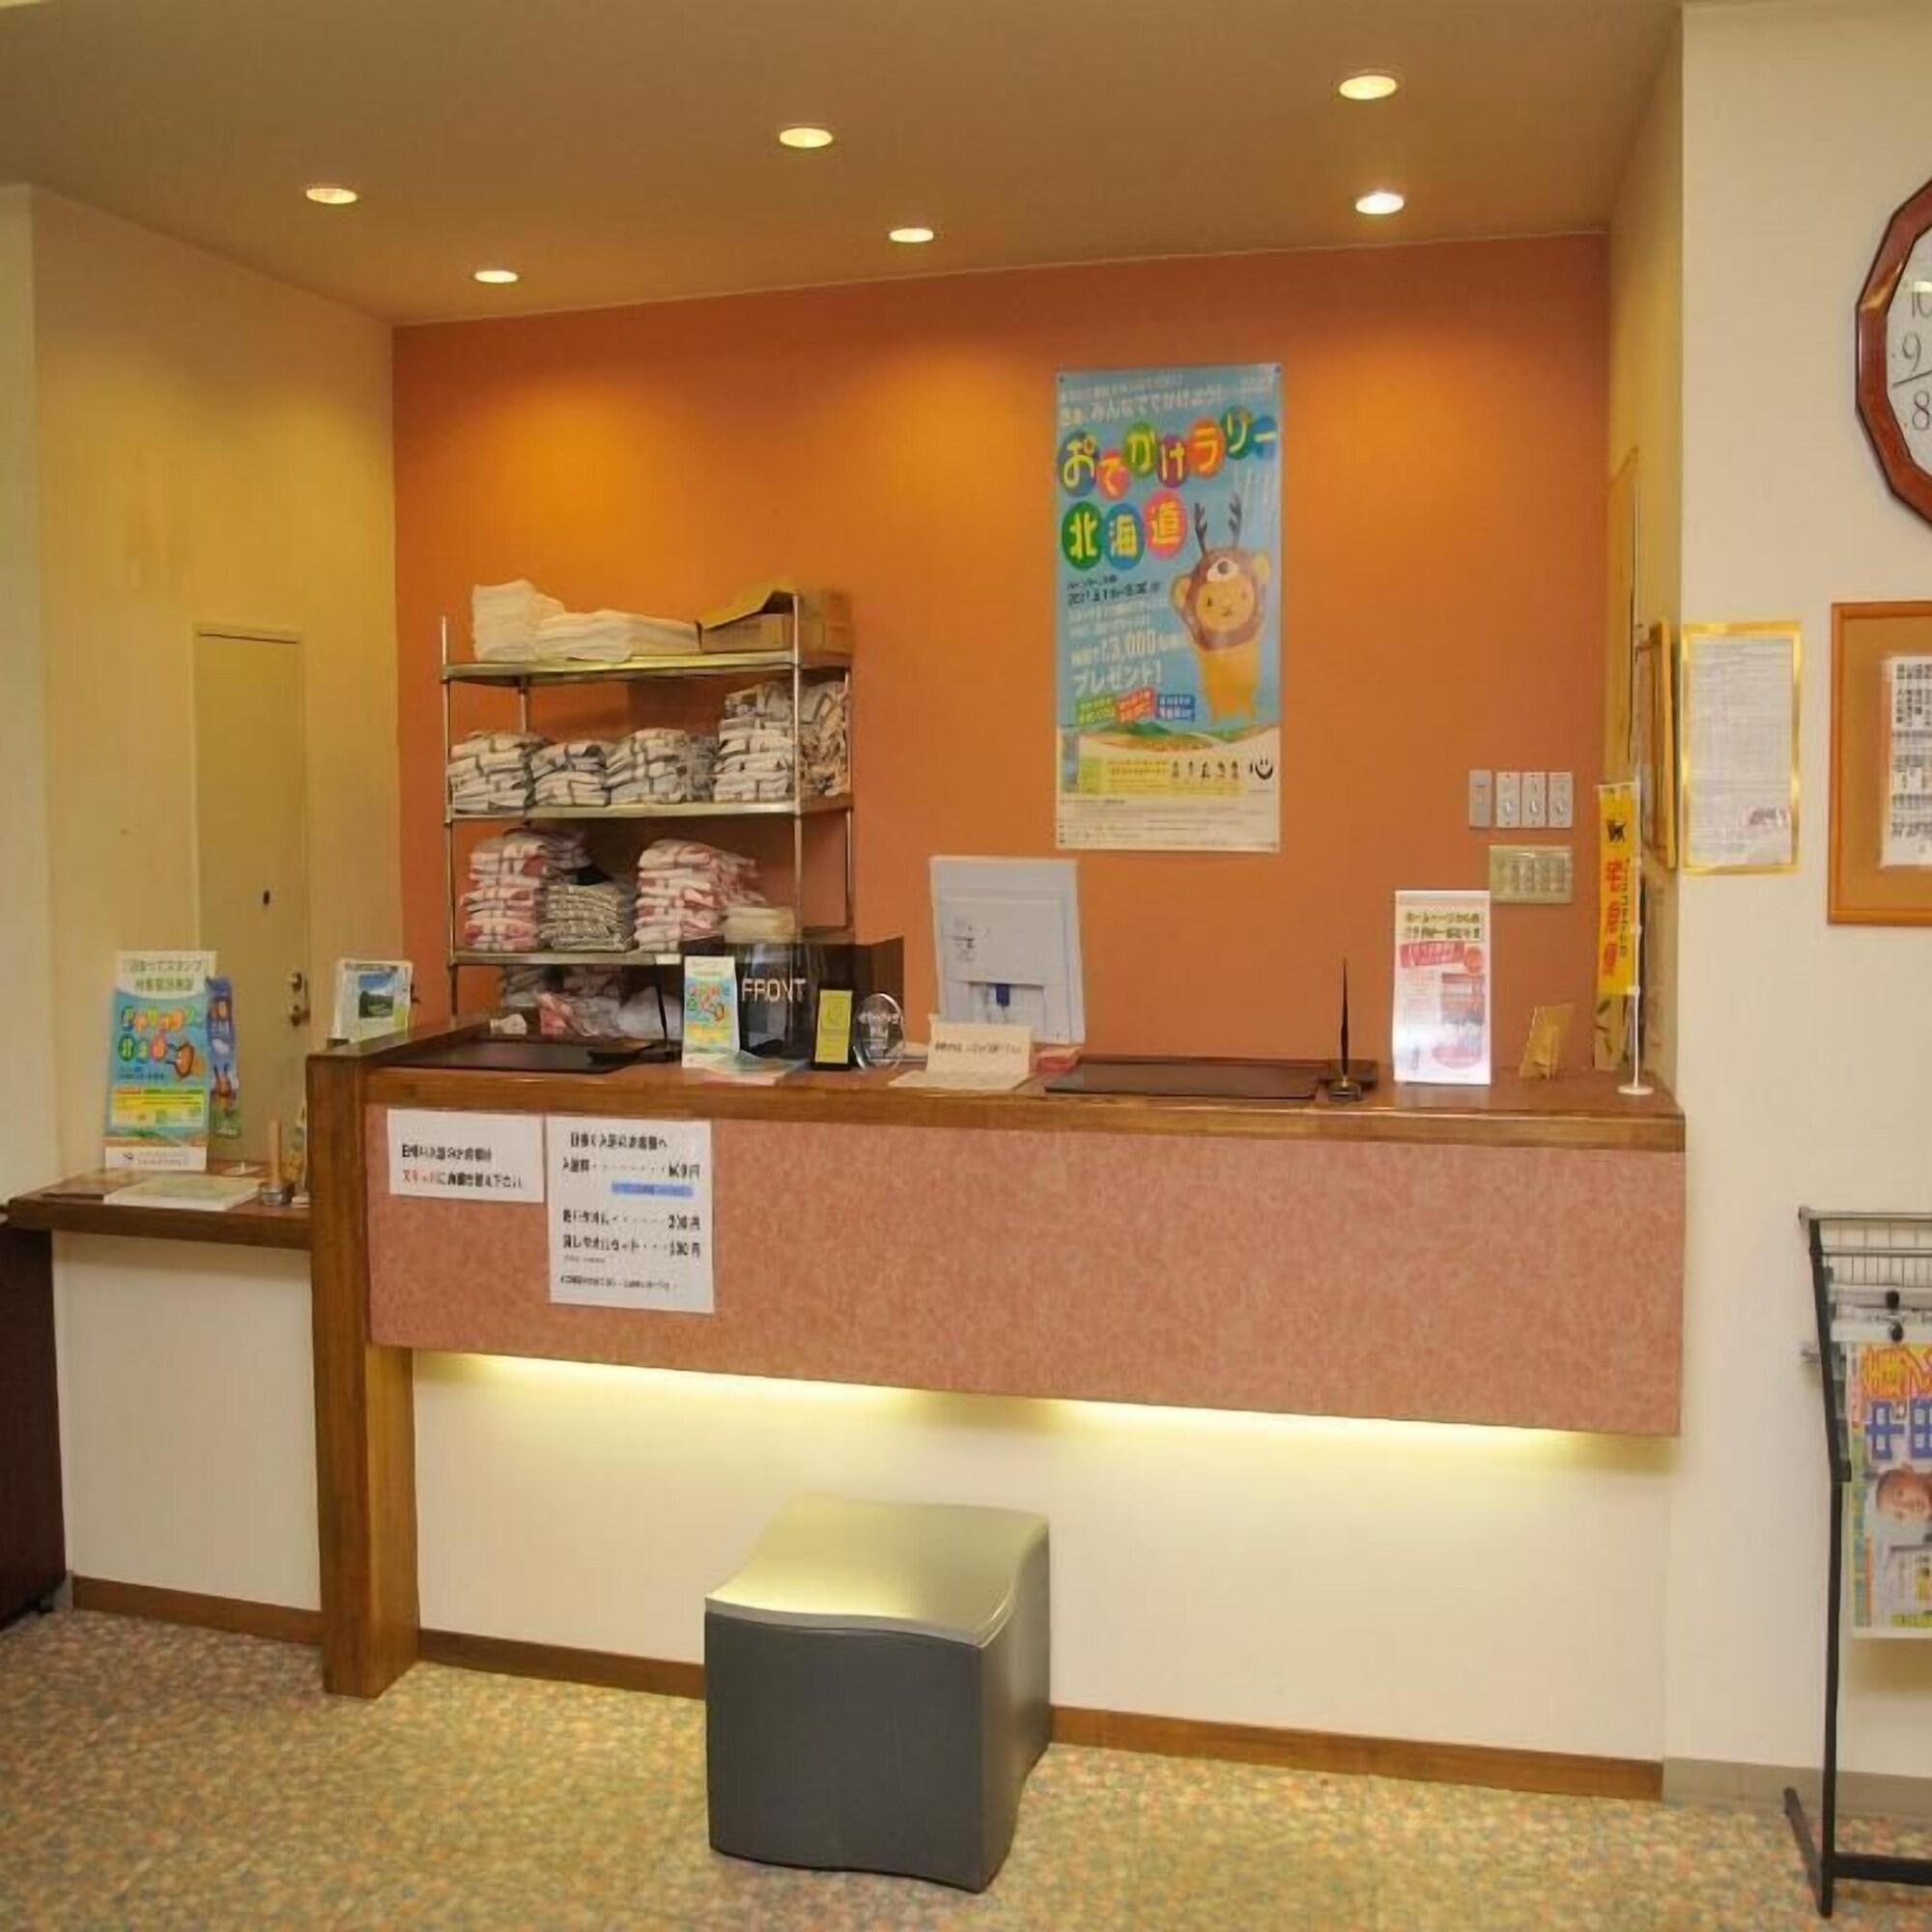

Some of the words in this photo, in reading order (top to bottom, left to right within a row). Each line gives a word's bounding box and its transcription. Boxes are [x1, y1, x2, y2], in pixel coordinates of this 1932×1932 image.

[1902, 331, 1922, 372] 9
[1912, 389, 1931, 431] 8
[1068, 499, 1180, 559] 北海道
